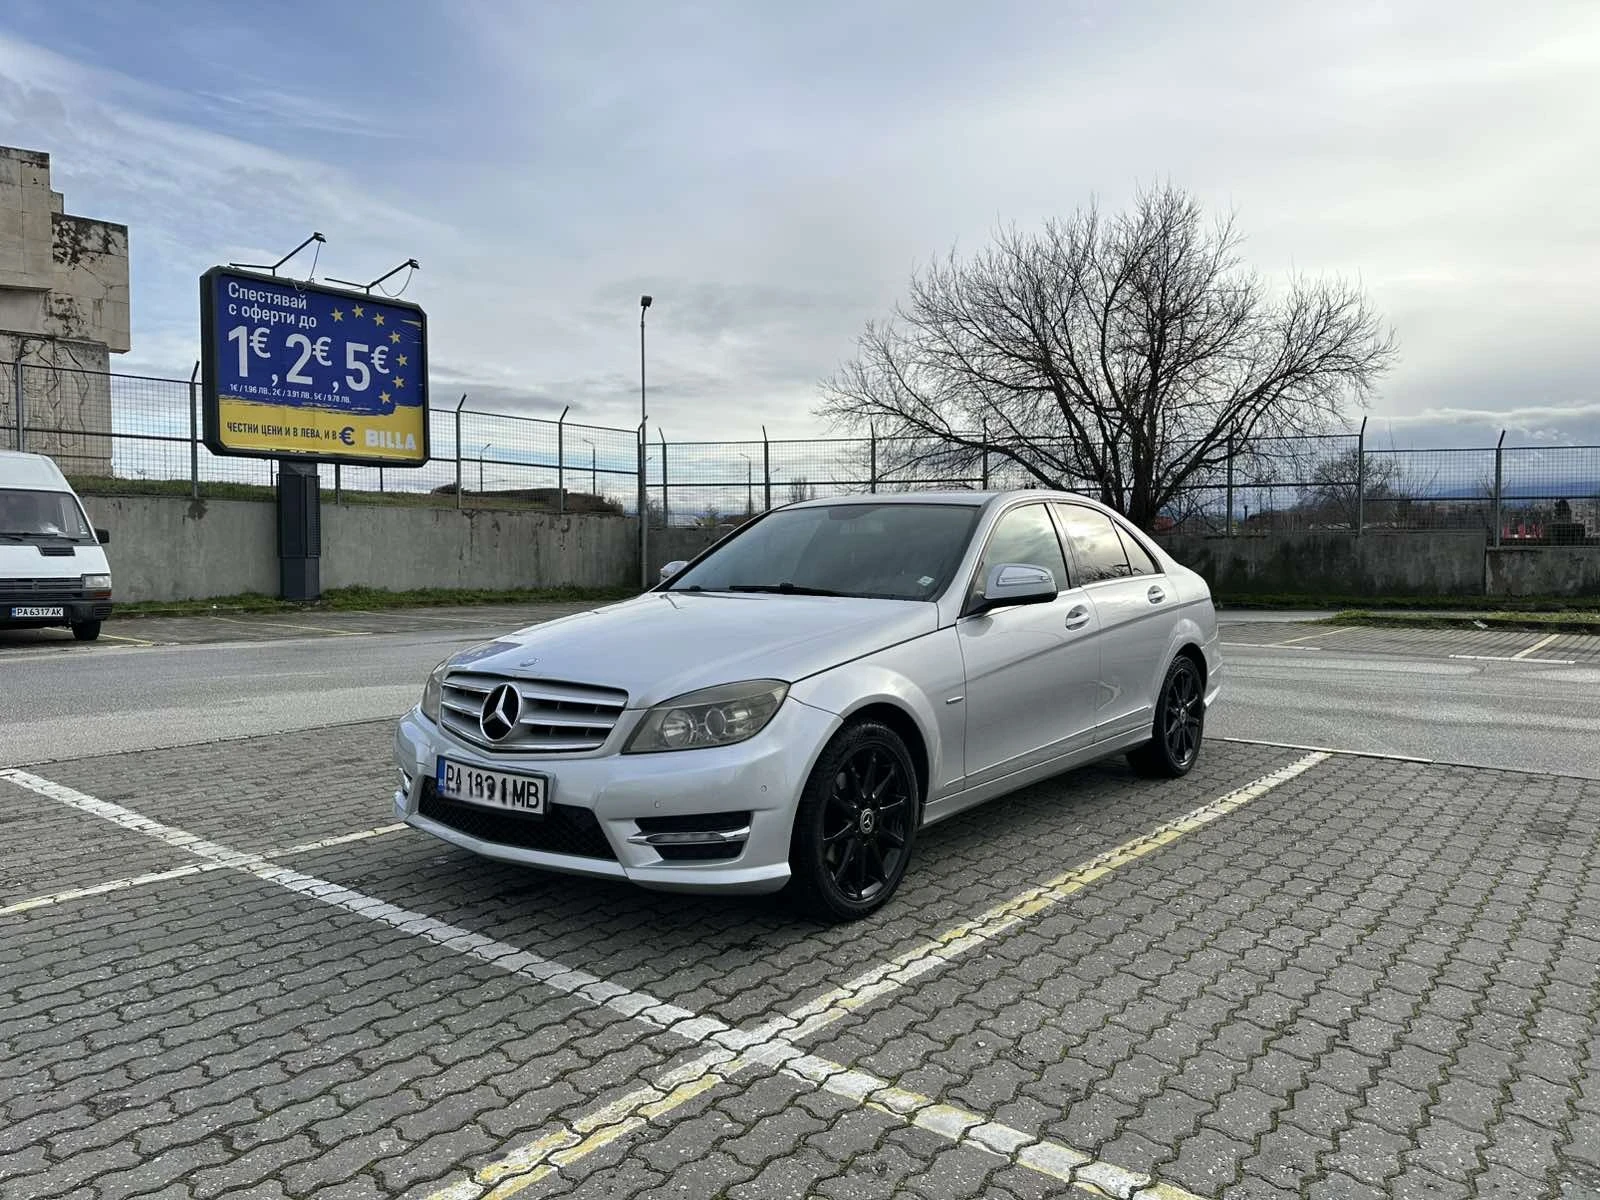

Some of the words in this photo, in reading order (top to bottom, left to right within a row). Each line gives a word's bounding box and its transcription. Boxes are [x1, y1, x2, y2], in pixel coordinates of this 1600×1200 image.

[228, 281, 307, 309] Спестявай
[228, 303, 237, 315] с
[241, 304, 295, 326] оферти
[298, 315, 317, 329] до
[345, 341, 390, 392] 5€
[244, 385, 257, 394] 1.96
[227, 422, 259, 434] ЧЕСТНИ
[261, 424, 283, 436] ЦЕНИ
[284, 425, 291, 437] И
[293, 427, 298, 437] В
[301, 427, 322, 440] ЛЕВА,
[324, 430, 330, 440] И
[365, 429, 417, 450] BILLA
